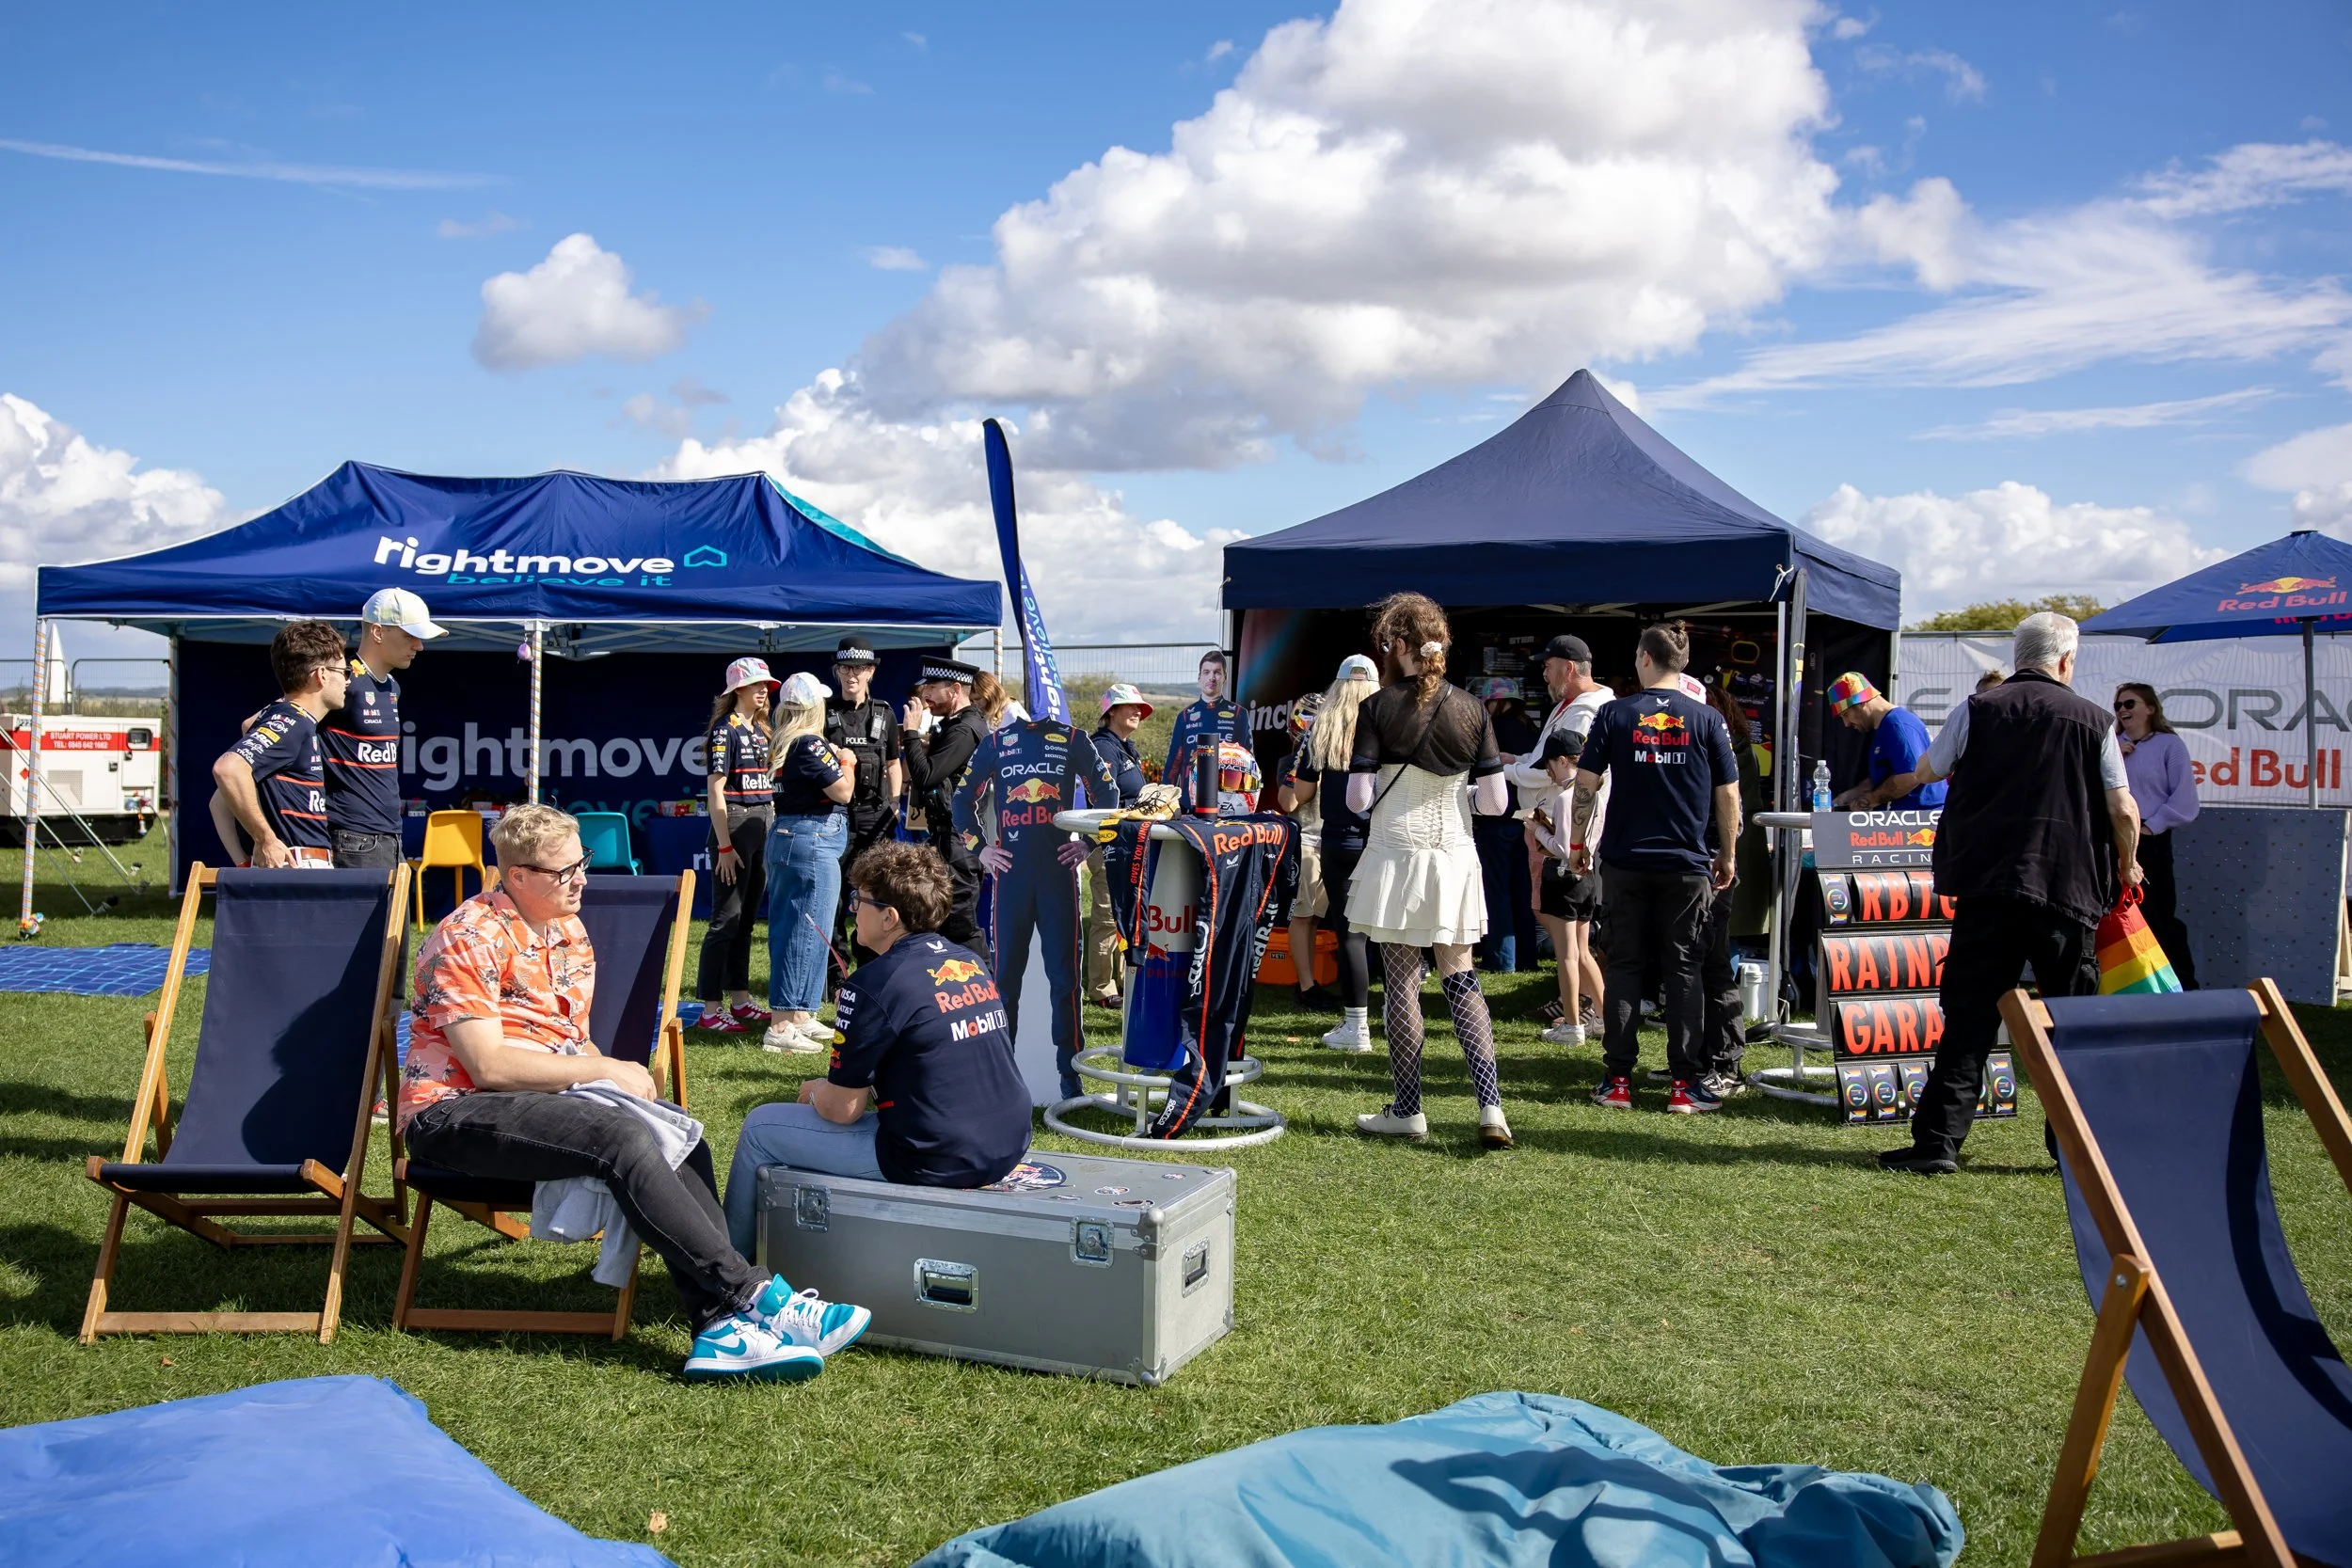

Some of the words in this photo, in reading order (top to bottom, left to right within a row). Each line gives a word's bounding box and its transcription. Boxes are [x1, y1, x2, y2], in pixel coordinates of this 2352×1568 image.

[373, 535, 675, 576] rightmove
[446, 572, 626, 587] believe
[640, 575, 673, 586] it
[2217, 595, 2280, 612] Red
[2284, 591, 2348, 608] Bull
[1024, 596, 1062, 690] believe
[2159, 688, 2352, 732] ORA
[271, 714, 296, 726] Mobil
[50, 732, 75, 740] STUART
[845, 736, 867, 745] POLICE
[1632, 729, 1661, 745] Red
[1661, 731, 1691, 746] Bull
[998, 748, 1016, 759] Mobil
[1634, 750, 1672, 764] Mobil
[1674, 752, 1685, 764] 1
[1000, 762, 1066, 779] ORACLE
[2249, 749, 2342, 789] Bull
[1220, 802, 1235, 812] EA
[1002, 805, 1032, 828] Red
[1036, 806, 1066, 824] Bu
[1848, 810, 1942, 827] ORACLE
[1213, 824, 1254, 856] Red
[1252, 824, 1283, 846] Bull
[1850, 832, 1877, 847] Red
[1878, 831, 1904, 846] Bull
[1133, 844, 1144, 861] YOU
[1130, 862, 1140, 884] GIVES
[1147, 905, 1199, 934] Bull
[934, 984, 976, 1014] Red
[970, 980, 1000, 1006] Bull
[839, 1005, 854, 1016] AT&T
[950, 1015, 995, 1042] Mobil
[995, 1010, 1006, 1028] 1
[1157, 1098, 1177, 1126] sparco
